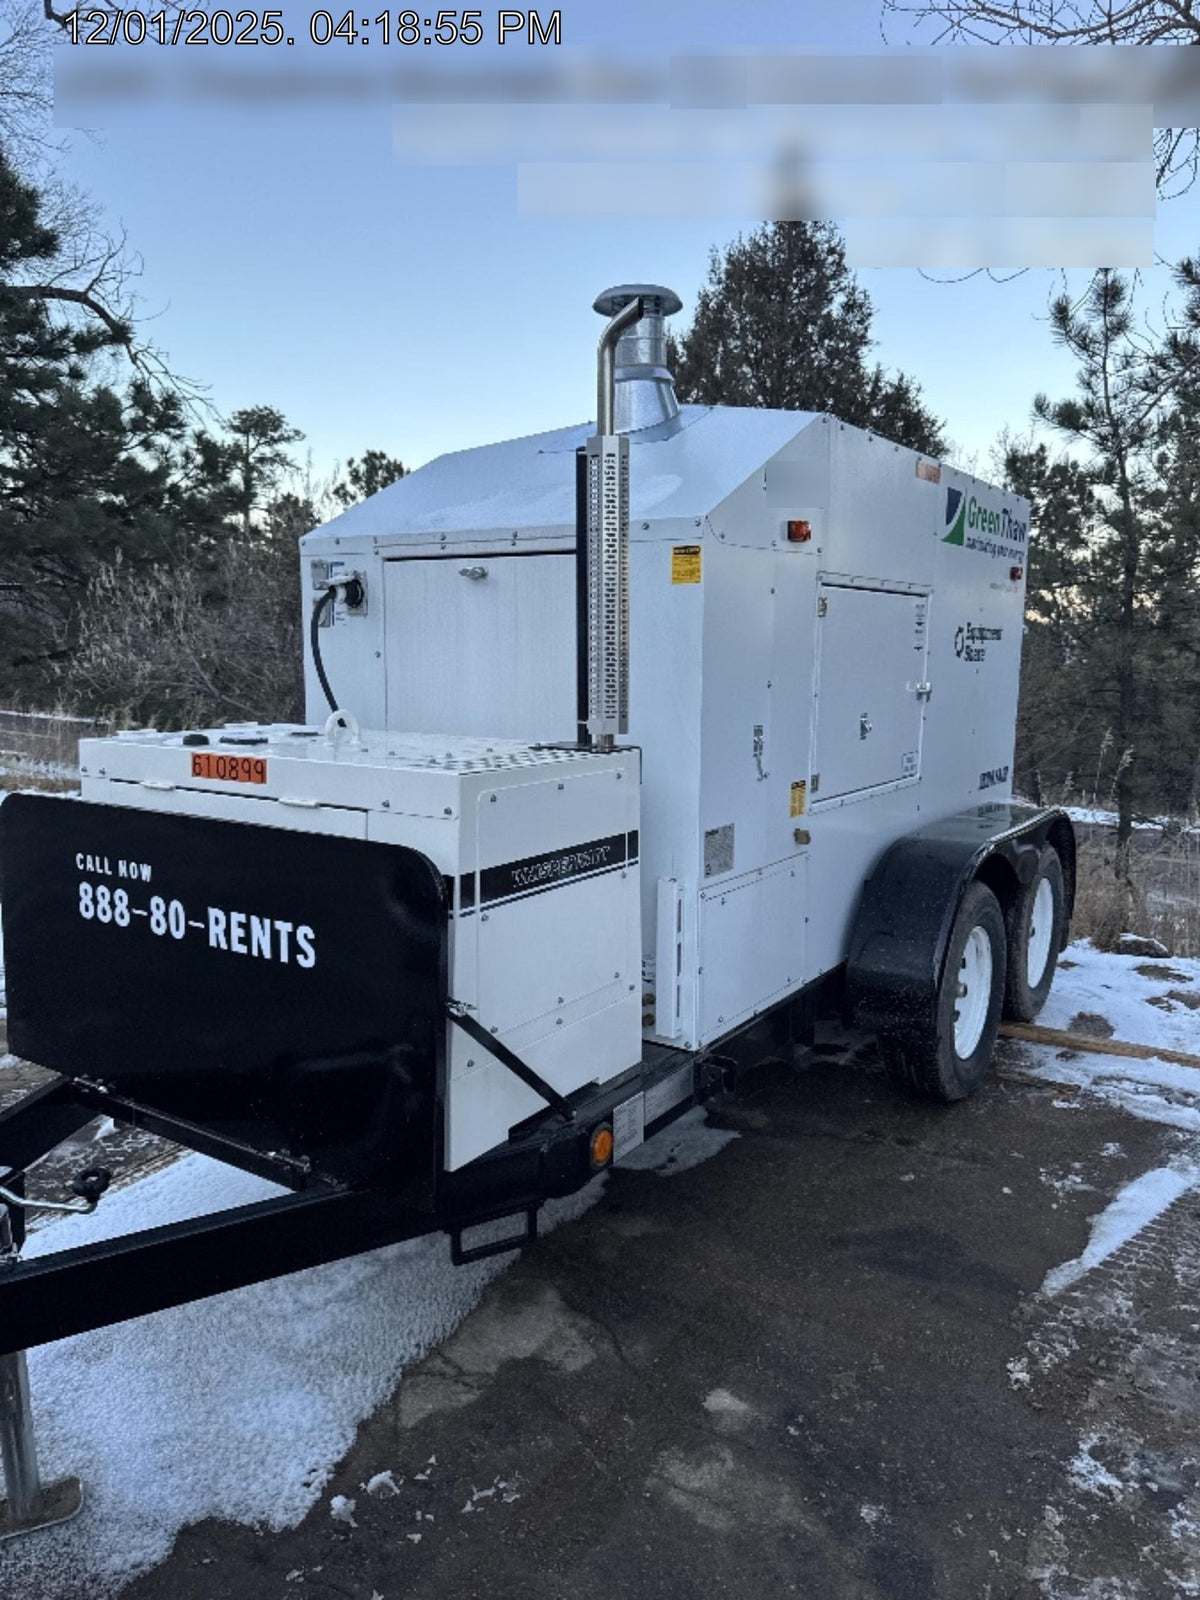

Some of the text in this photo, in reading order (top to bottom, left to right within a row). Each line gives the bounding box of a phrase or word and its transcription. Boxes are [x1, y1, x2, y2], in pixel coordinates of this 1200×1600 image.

[193, 755, 264, 783] 610899
[76, 853, 152, 882] CALL NOW
[79, 881, 316, 968] 888-80-RENTS
